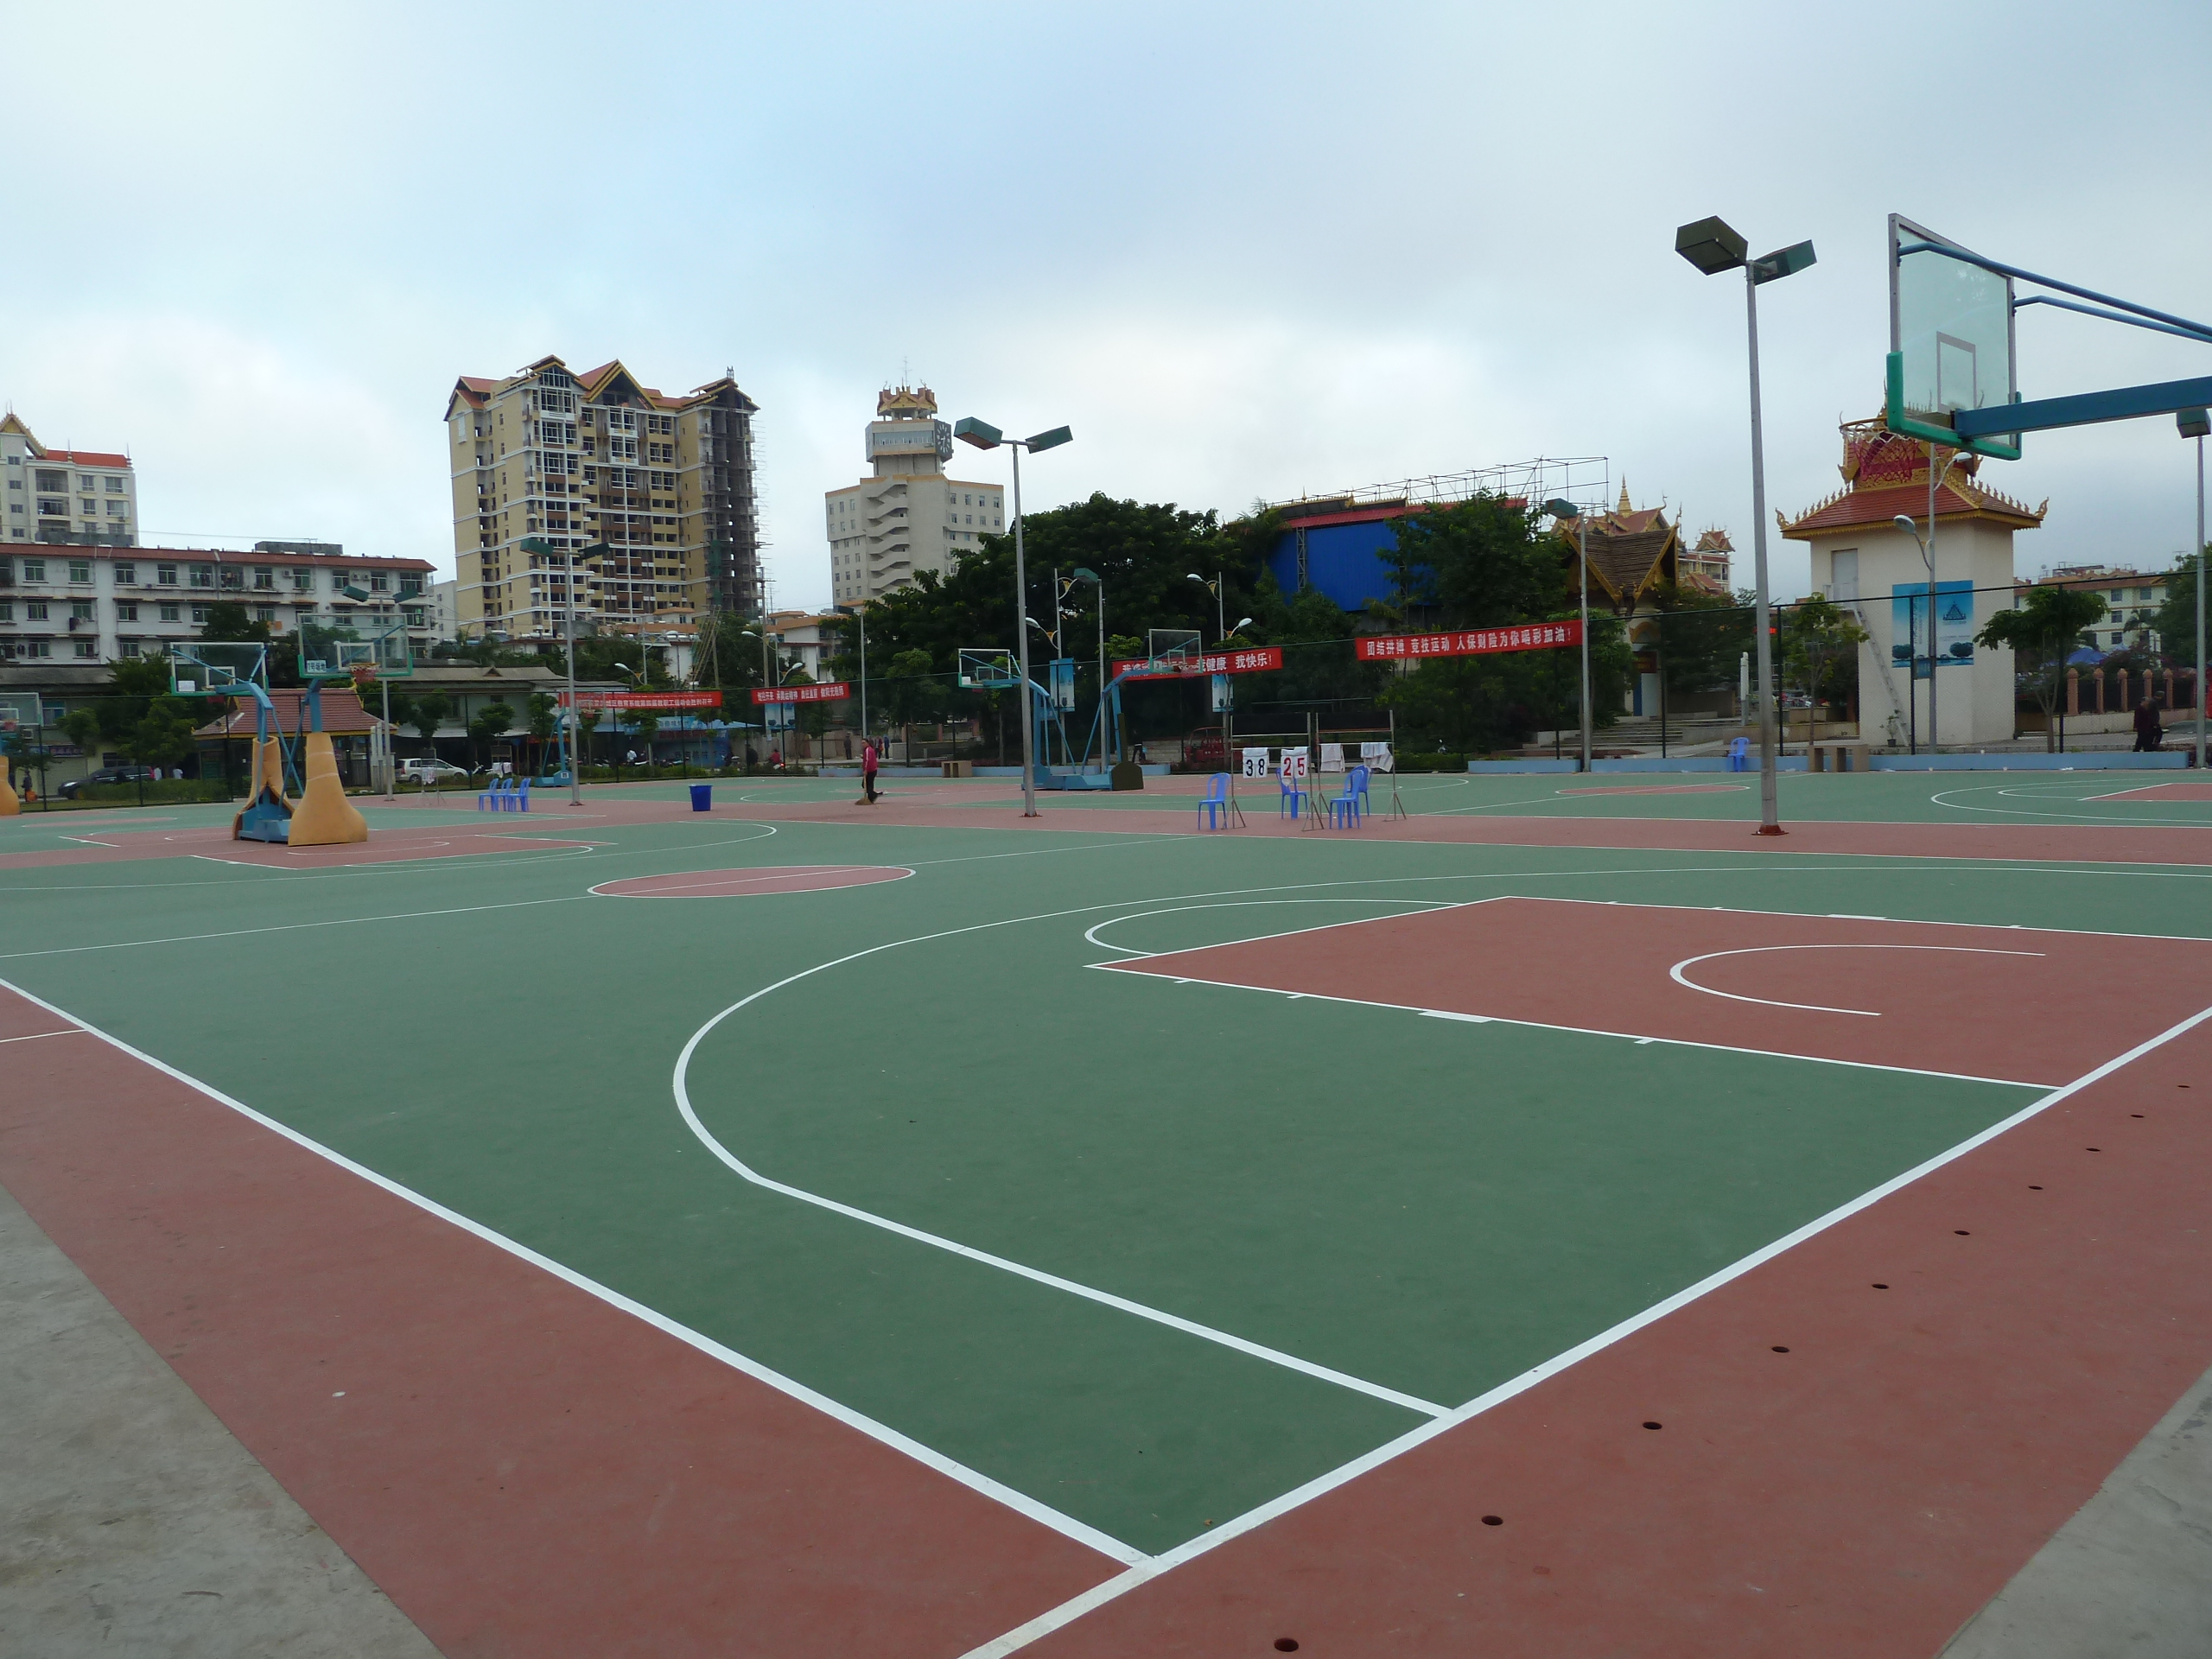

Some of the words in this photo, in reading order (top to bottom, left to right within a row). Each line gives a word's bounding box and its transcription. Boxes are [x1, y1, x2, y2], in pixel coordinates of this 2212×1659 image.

[1367, 639, 1405, 657] 团结拼搏
[1410, 636, 1450, 654] 竞技运动
[1245, 758, 1265, 777] 38
[1283, 757, 1306, 777] 25
